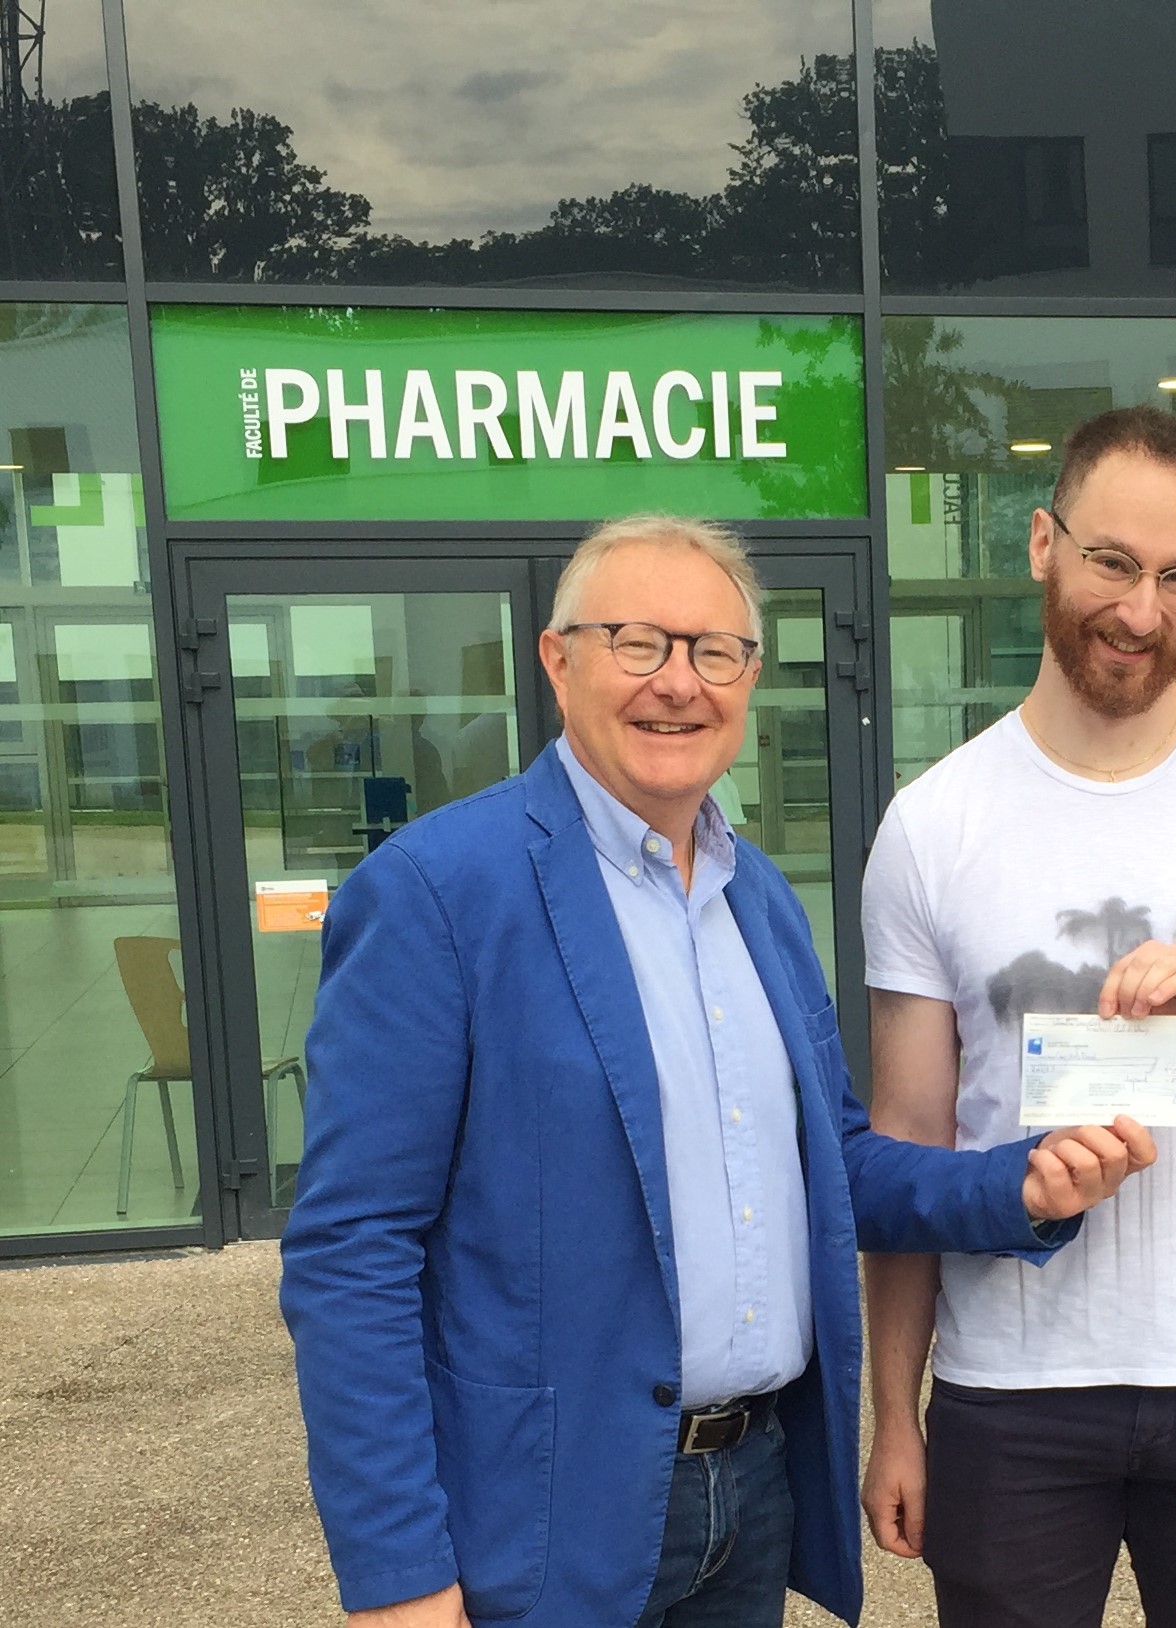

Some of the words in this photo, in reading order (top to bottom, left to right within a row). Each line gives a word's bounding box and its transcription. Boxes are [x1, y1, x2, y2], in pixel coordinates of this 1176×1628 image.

[240, 368, 258, 389] DE
[238, 392, 263, 458] FACULTÉ
[265, 367, 787, 460] PHARMACIE
